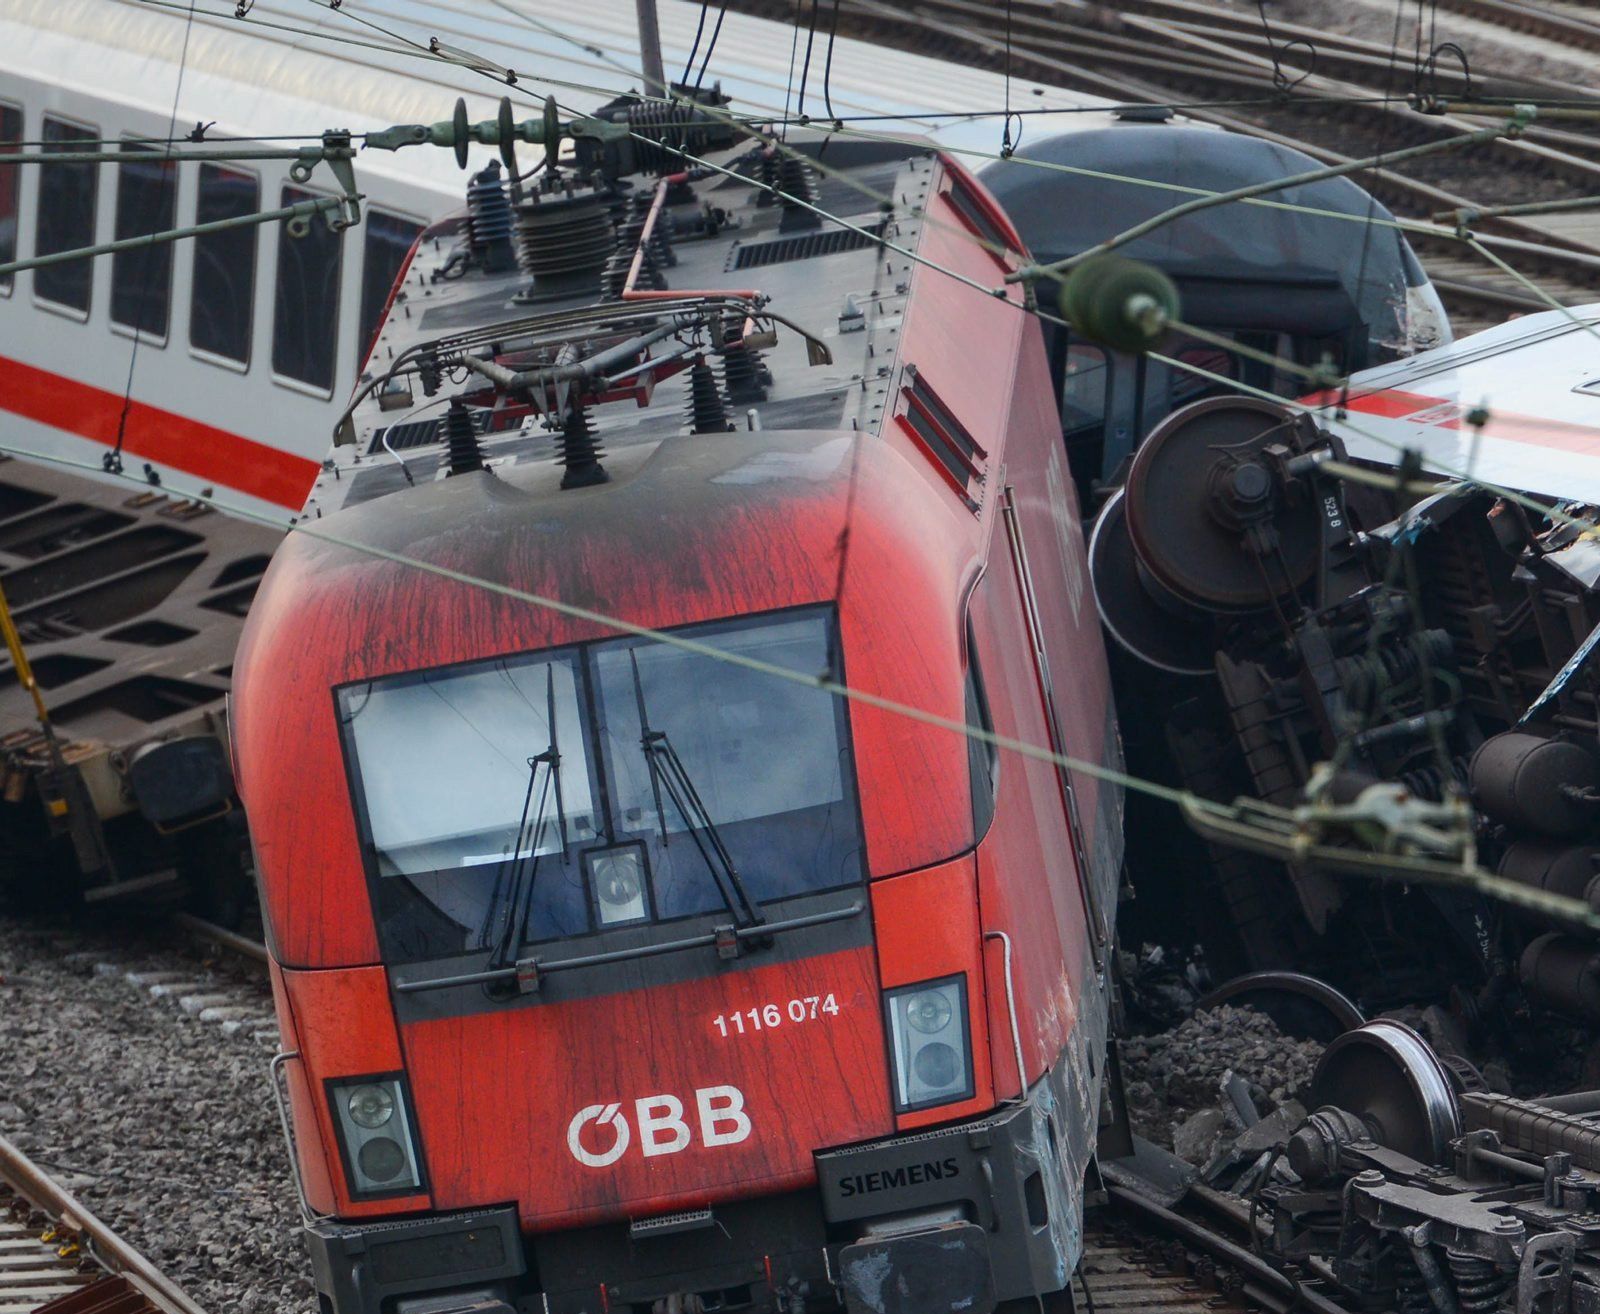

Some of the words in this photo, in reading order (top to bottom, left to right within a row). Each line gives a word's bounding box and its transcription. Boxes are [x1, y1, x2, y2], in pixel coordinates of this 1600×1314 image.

[713, 1004, 781, 1037] 1116
[788, 993, 840, 1025] 074
[567, 1085, 752, 1168] ÖBB
[839, 1157, 960, 1198] SIEMENS
